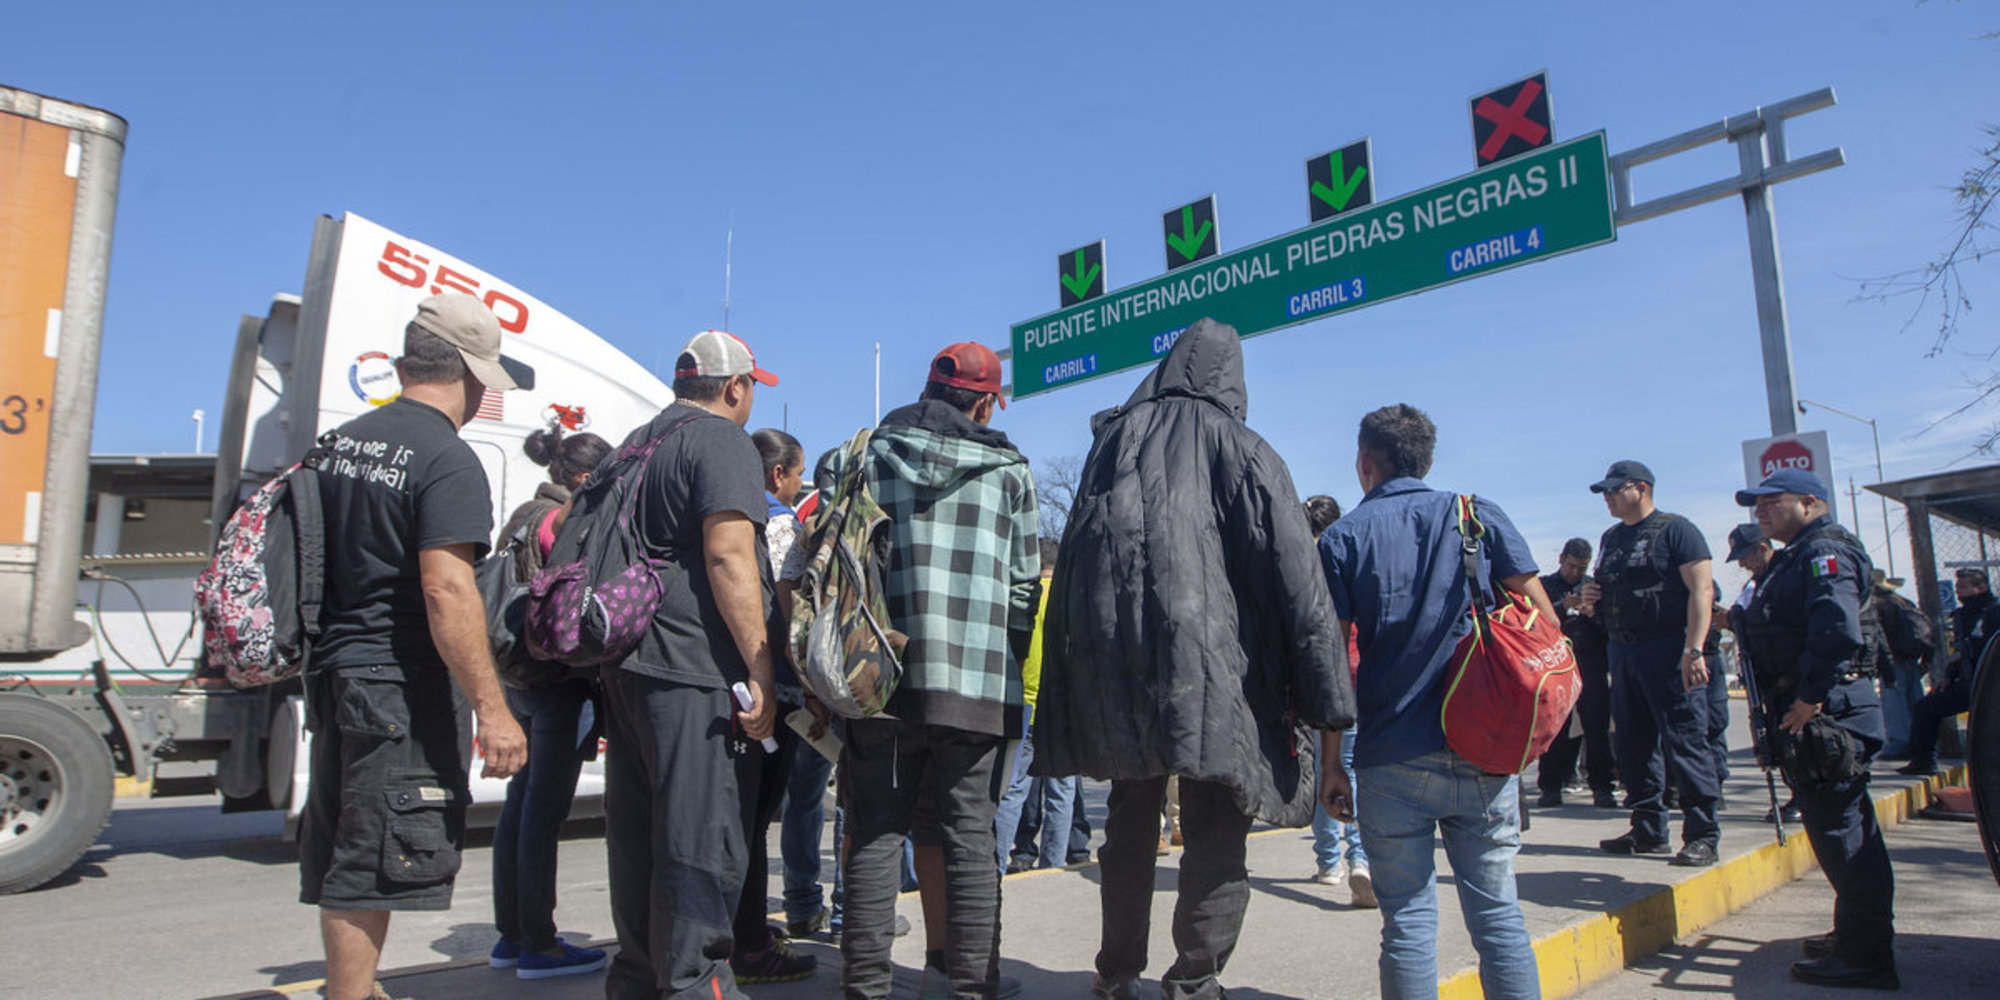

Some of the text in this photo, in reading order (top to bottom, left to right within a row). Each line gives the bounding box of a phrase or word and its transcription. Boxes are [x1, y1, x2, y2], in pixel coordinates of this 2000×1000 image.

[1024, 154, 1578, 352] PUENTE INTERNACIONAL PIEDRAS NEGRAS II
[1451, 227, 1540, 272] CARRIL 4
[378, 240, 529, 334] 550
[1290, 278, 1363, 315] CARRIL 3
[1154, 328, 1187, 353] CAR
[1045, 354, 1096, 383] CARRIL 1
[391, 445, 414, 465] is
[1765, 456, 1809, 474] ALTO
